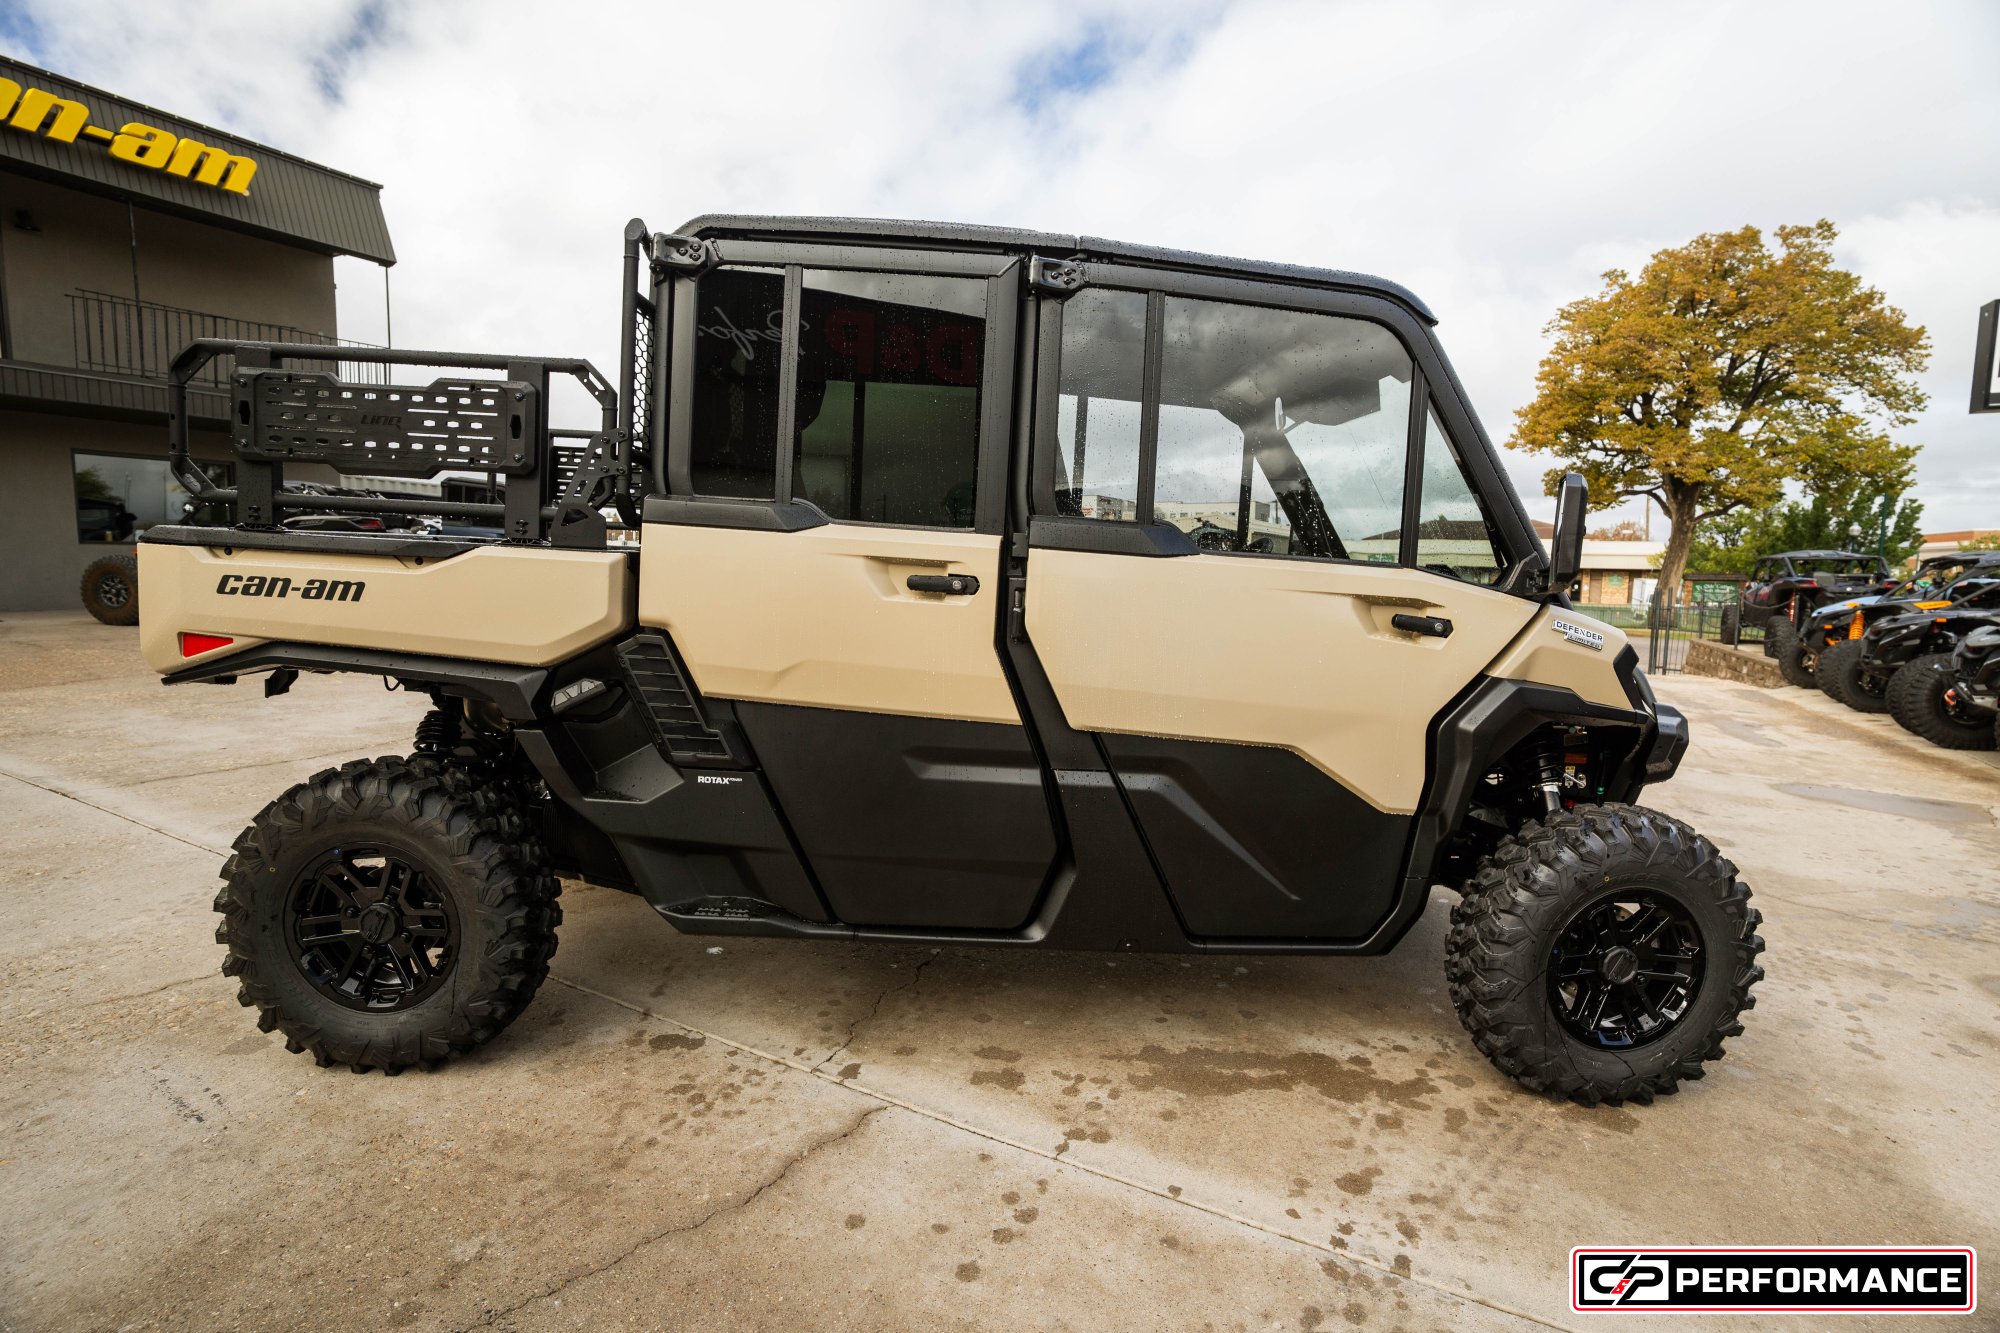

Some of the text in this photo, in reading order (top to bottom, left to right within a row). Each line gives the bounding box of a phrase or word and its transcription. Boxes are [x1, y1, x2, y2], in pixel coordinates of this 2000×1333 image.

[216, 574, 366, 602] can-am
[1556, 621, 1603, 641] DEFENDER
[697, 775, 730, 784] ROTAX
